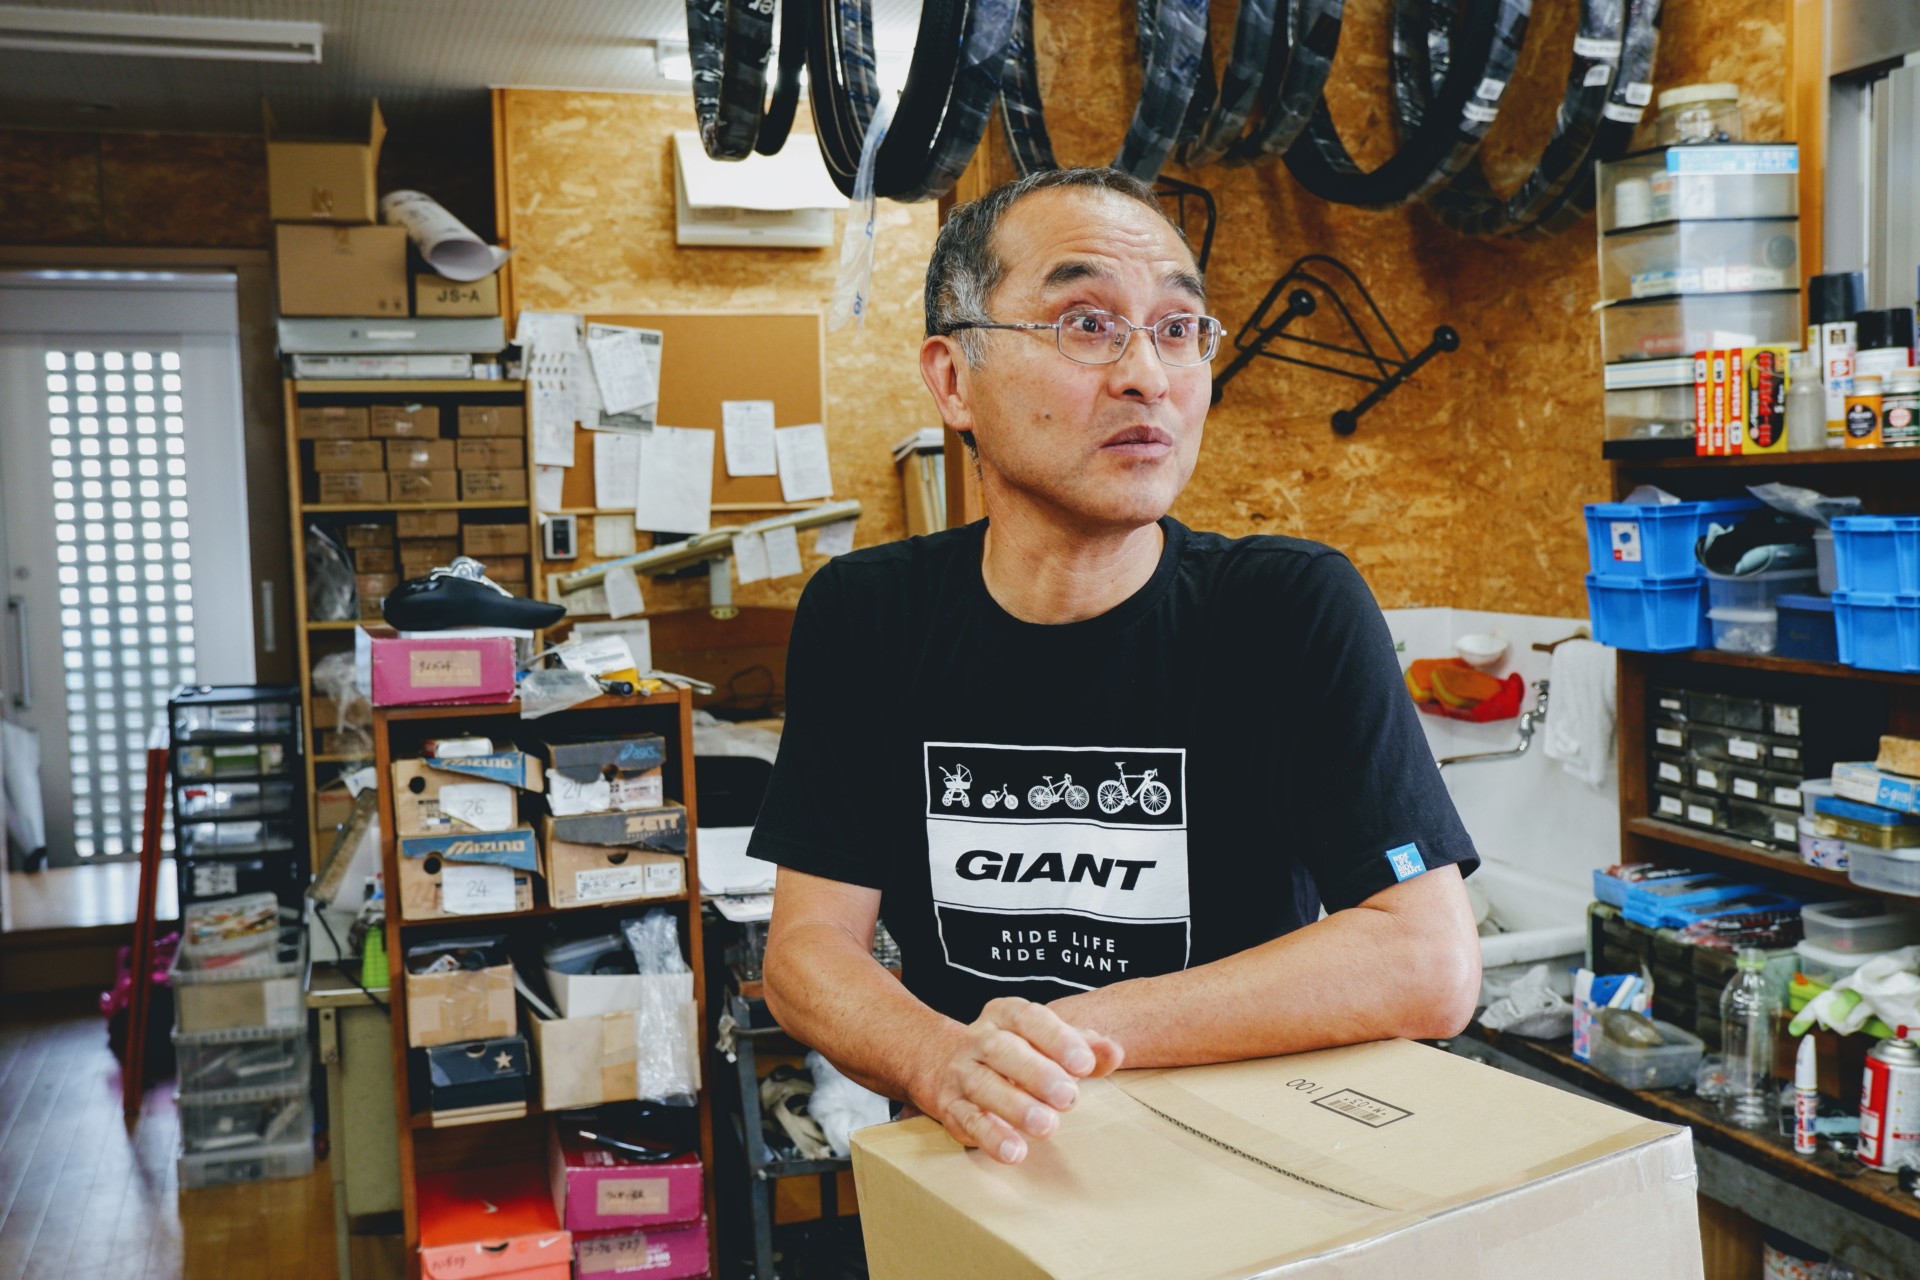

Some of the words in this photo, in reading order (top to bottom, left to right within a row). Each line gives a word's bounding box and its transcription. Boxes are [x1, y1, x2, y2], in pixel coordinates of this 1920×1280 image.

[436, 289, 480, 303] JS-A
[464, 799, 486, 817] 26
[625, 812, 680, 834] ZETT
[955, 850, 1157, 891] GIANT
[466, 880, 489, 898] 24
[1002, 930, 1057, 943] RIDE
[1073, 932, 1115, 953] LIFE
[991, 947, 1045, 961] RIDE
[1061, 950, 1129, 972] GIANT
[1286, 1078, 1323, 1095] 100
